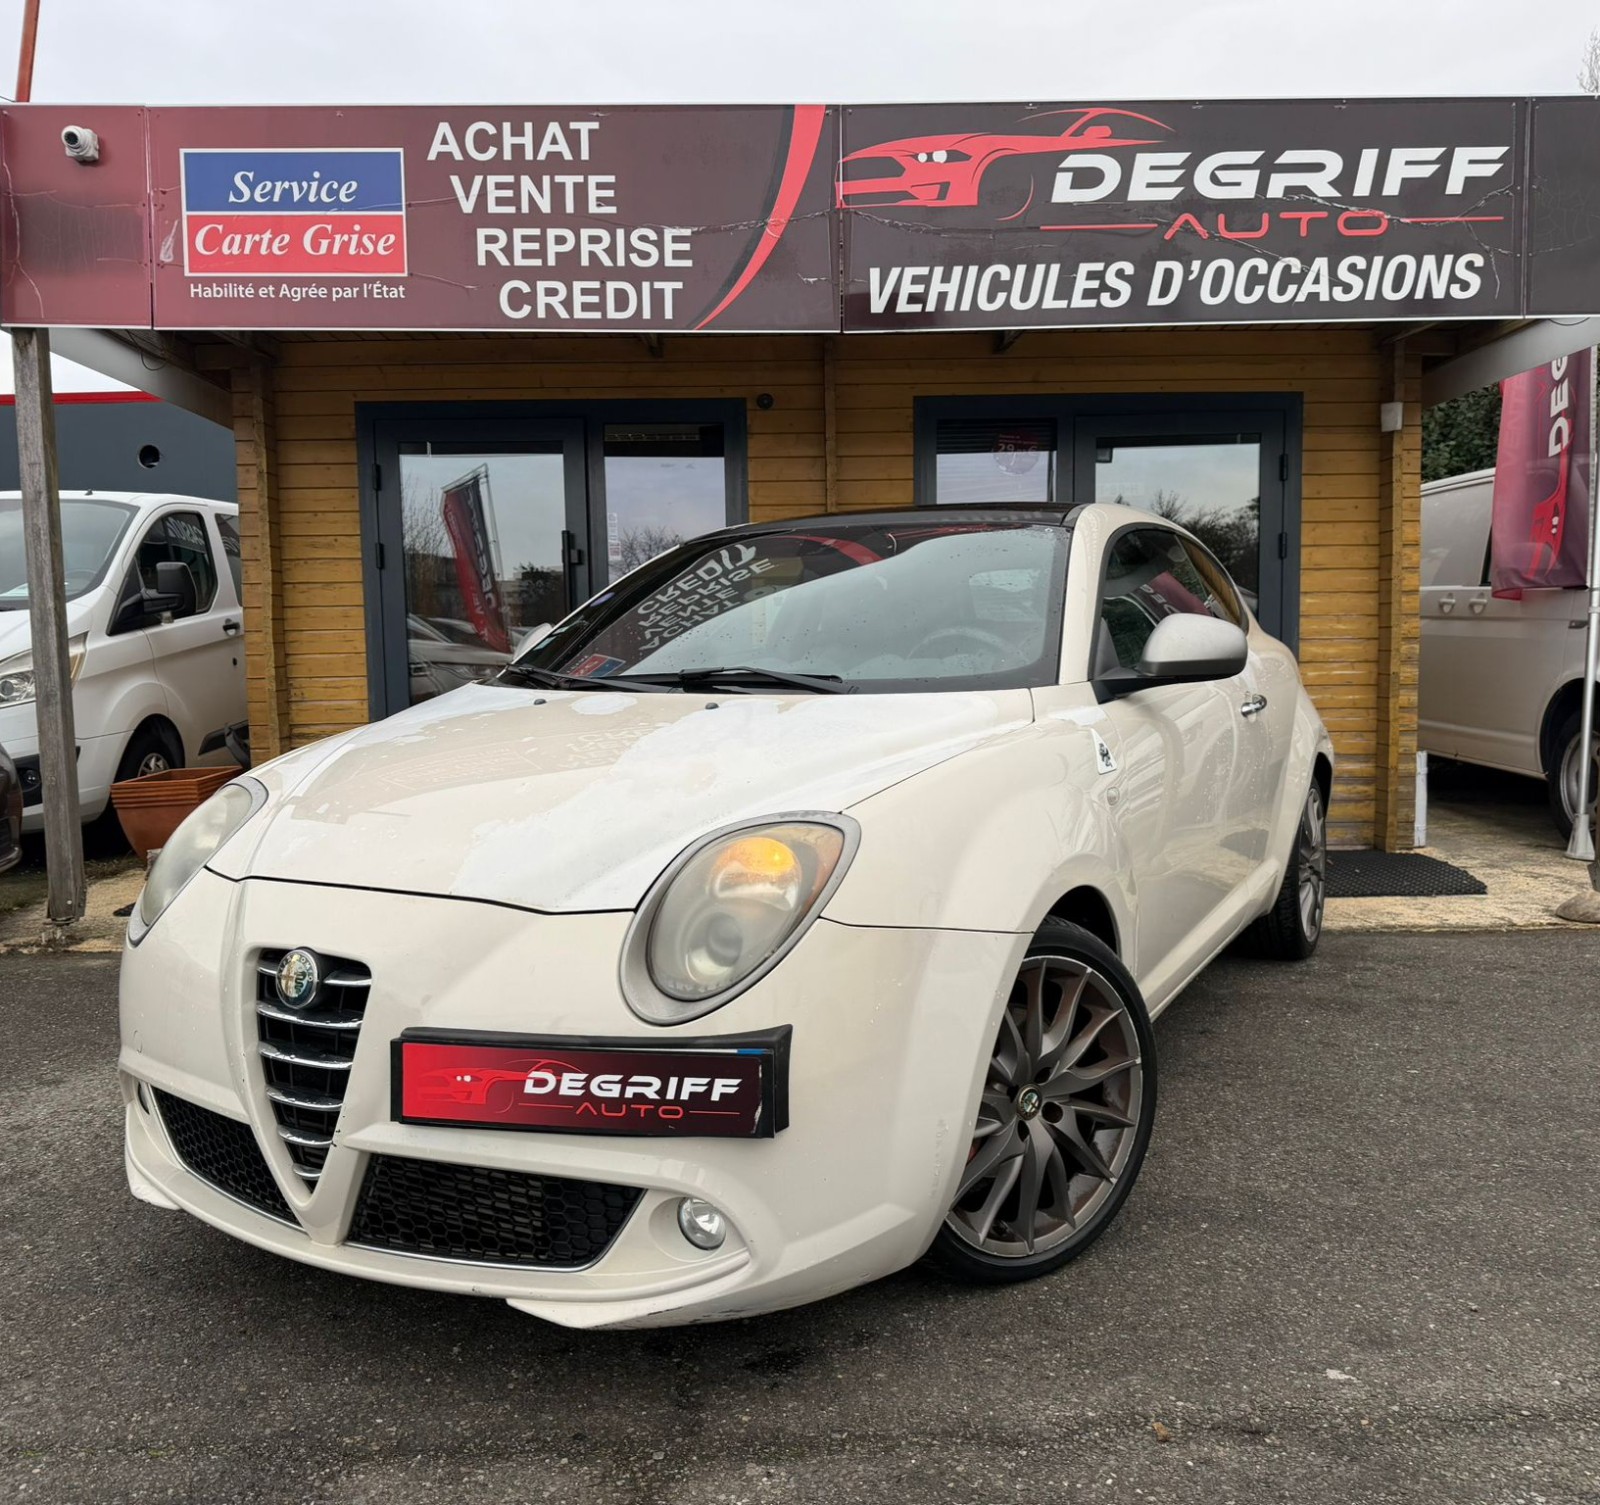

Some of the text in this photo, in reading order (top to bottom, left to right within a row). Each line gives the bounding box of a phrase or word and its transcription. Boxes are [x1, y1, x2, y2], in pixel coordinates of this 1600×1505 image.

[427, 121, 600, 161] ACHAT
[228, 170, 359, 204] Service
[1051, 146, 1510, 203] DEGRIFF
[450, 174, 617, 214] VENTE
[194, 223, 396, 257] Carte Grise
[1164, 210, 1390, 240] AUTO
[477, 227, 693, 267] REPRISE
[190, 281, 405, 301] Habilité et Agrée par l'État
[499, 280, 683, 320] CREDIT
[869, 253, 1484, 314] VEHICULES D'OCCASIONS
[523, 1071, 742, 1101] DEGRIFF
[575, 1103, 684, 1119] AUTO
